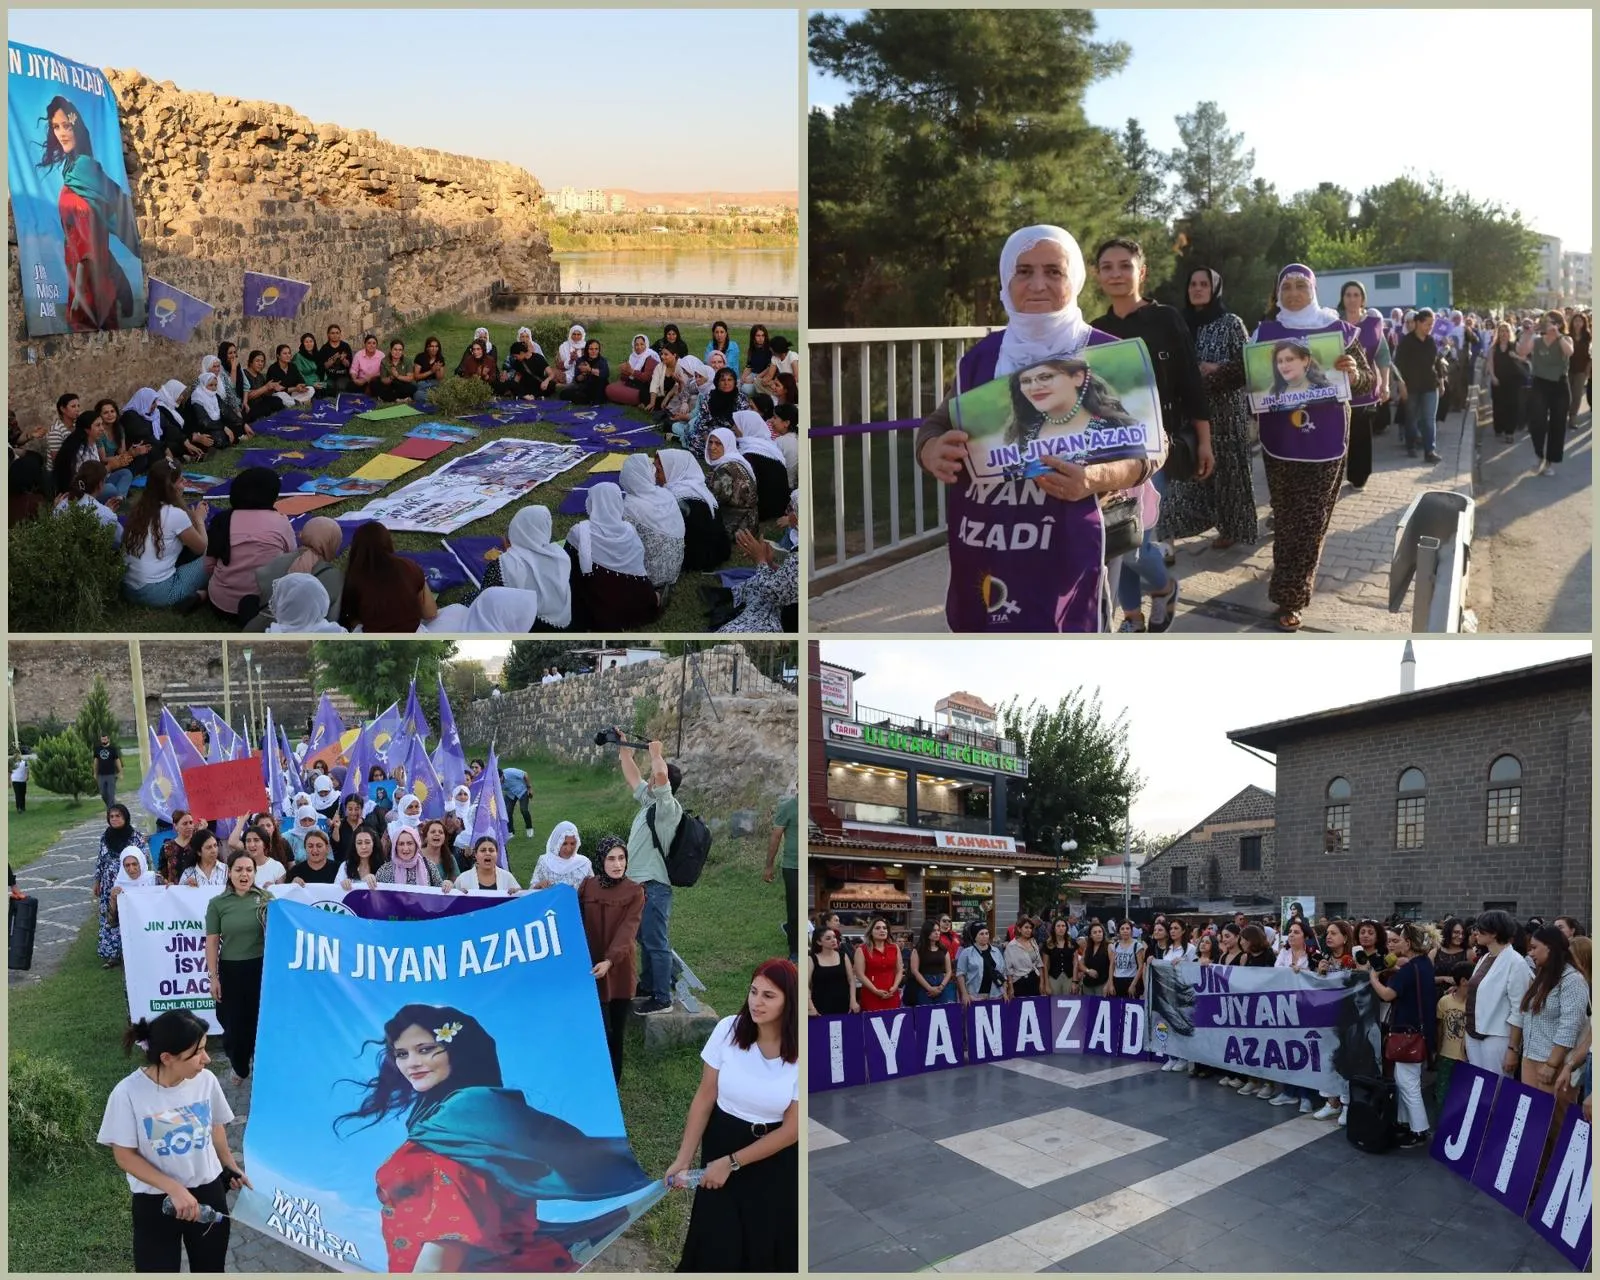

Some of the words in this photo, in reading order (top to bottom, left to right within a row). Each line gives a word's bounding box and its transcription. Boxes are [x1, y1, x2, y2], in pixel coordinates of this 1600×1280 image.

[28, 53, 69, 85] JIYAN
[1261, 396, 1275, 405] JIN
[1279, 392, 1306, 403] JIYAN
[987, 446, 1019, 468] JIN
[1024, 434, 1086, 460] JIYAN
[1090, 423, 1147, 449] AZADÎ
[958, 515, 1056, 551] AZADÎ
[945, 835, 1008, 849] KAHVALTI
[144, 921, 165, 931] JIN
[167, 920, 203, 930] JIYAN
[288, 929, 340, 974] JIN
[351, 943, 448, 983] JIYAN
[458, 909, 562, 977] AZADÎ
[1194, 965, 1233, 993] JIN
[1212, 994, 1300, 1026] JIYAN
[1016, 1000, 1163, 1057] AZAD
[1223, 1030, 1322, 1073] AZADÎ
[1444, 1075, 1592, 1249] JIN
[273, 1190, 361, 1260] MAHSA
